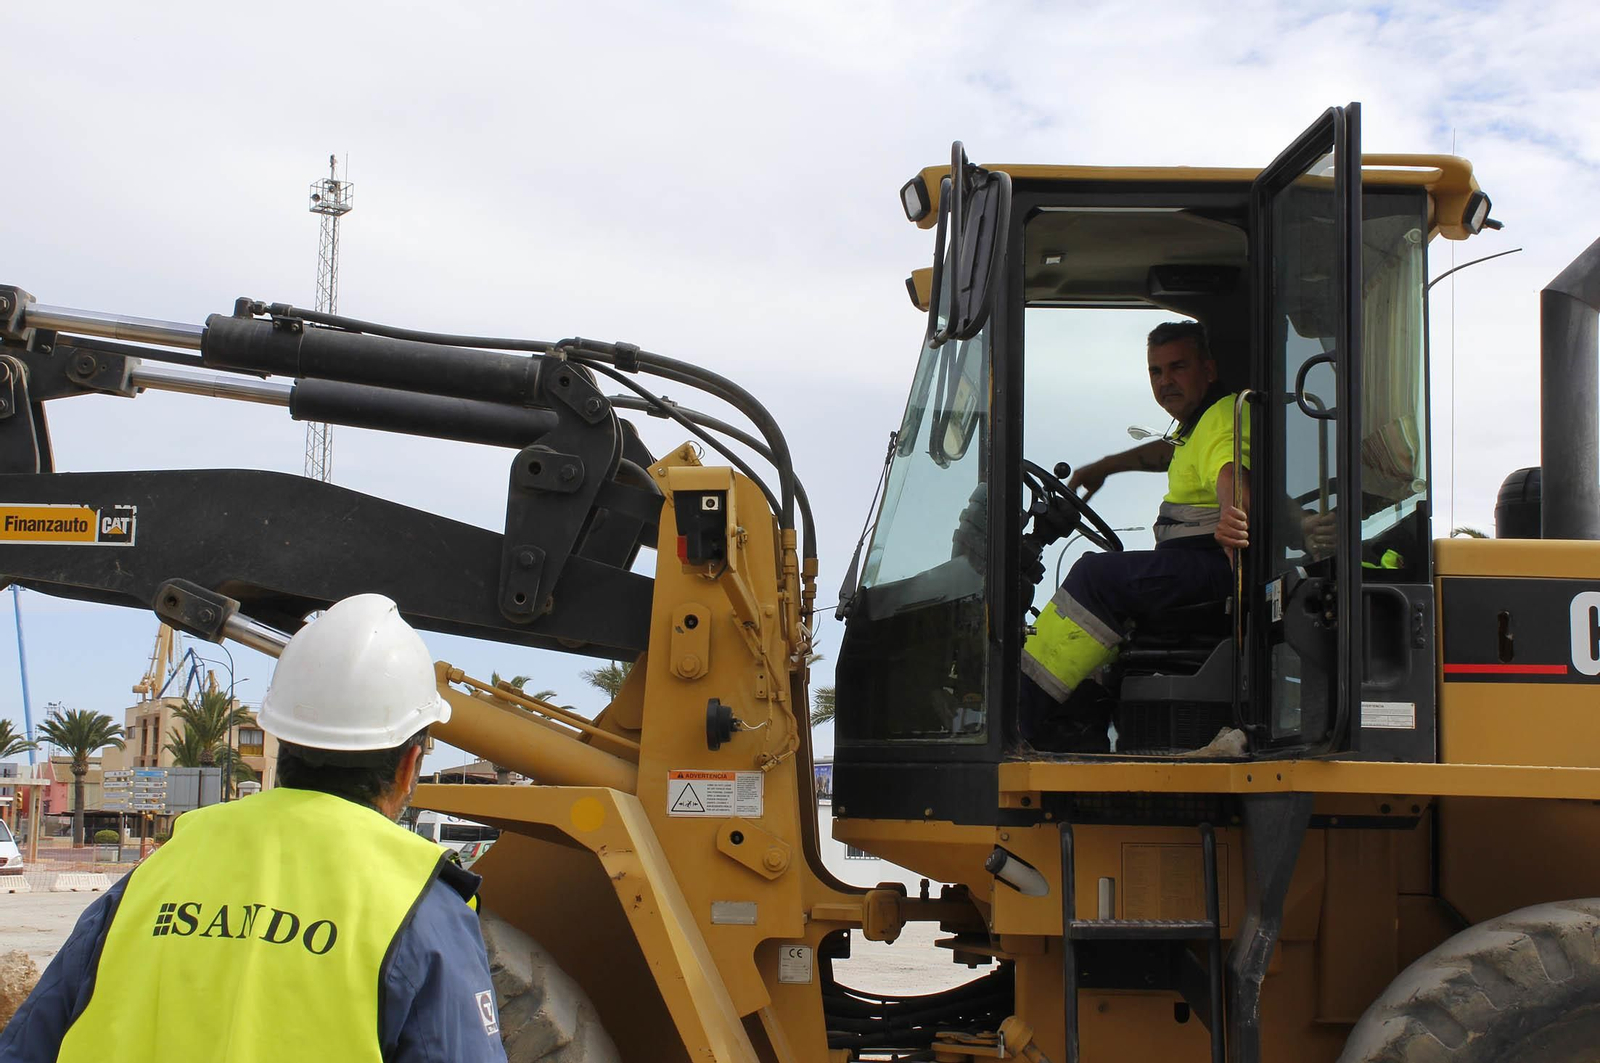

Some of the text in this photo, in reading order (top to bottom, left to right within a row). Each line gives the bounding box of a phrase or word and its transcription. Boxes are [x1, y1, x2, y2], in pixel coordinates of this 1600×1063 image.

[4, 515, 88, 533] Finanzauto
[101, 516, 129, 534] CAT
[171, 902, 338, 955] SANDO
